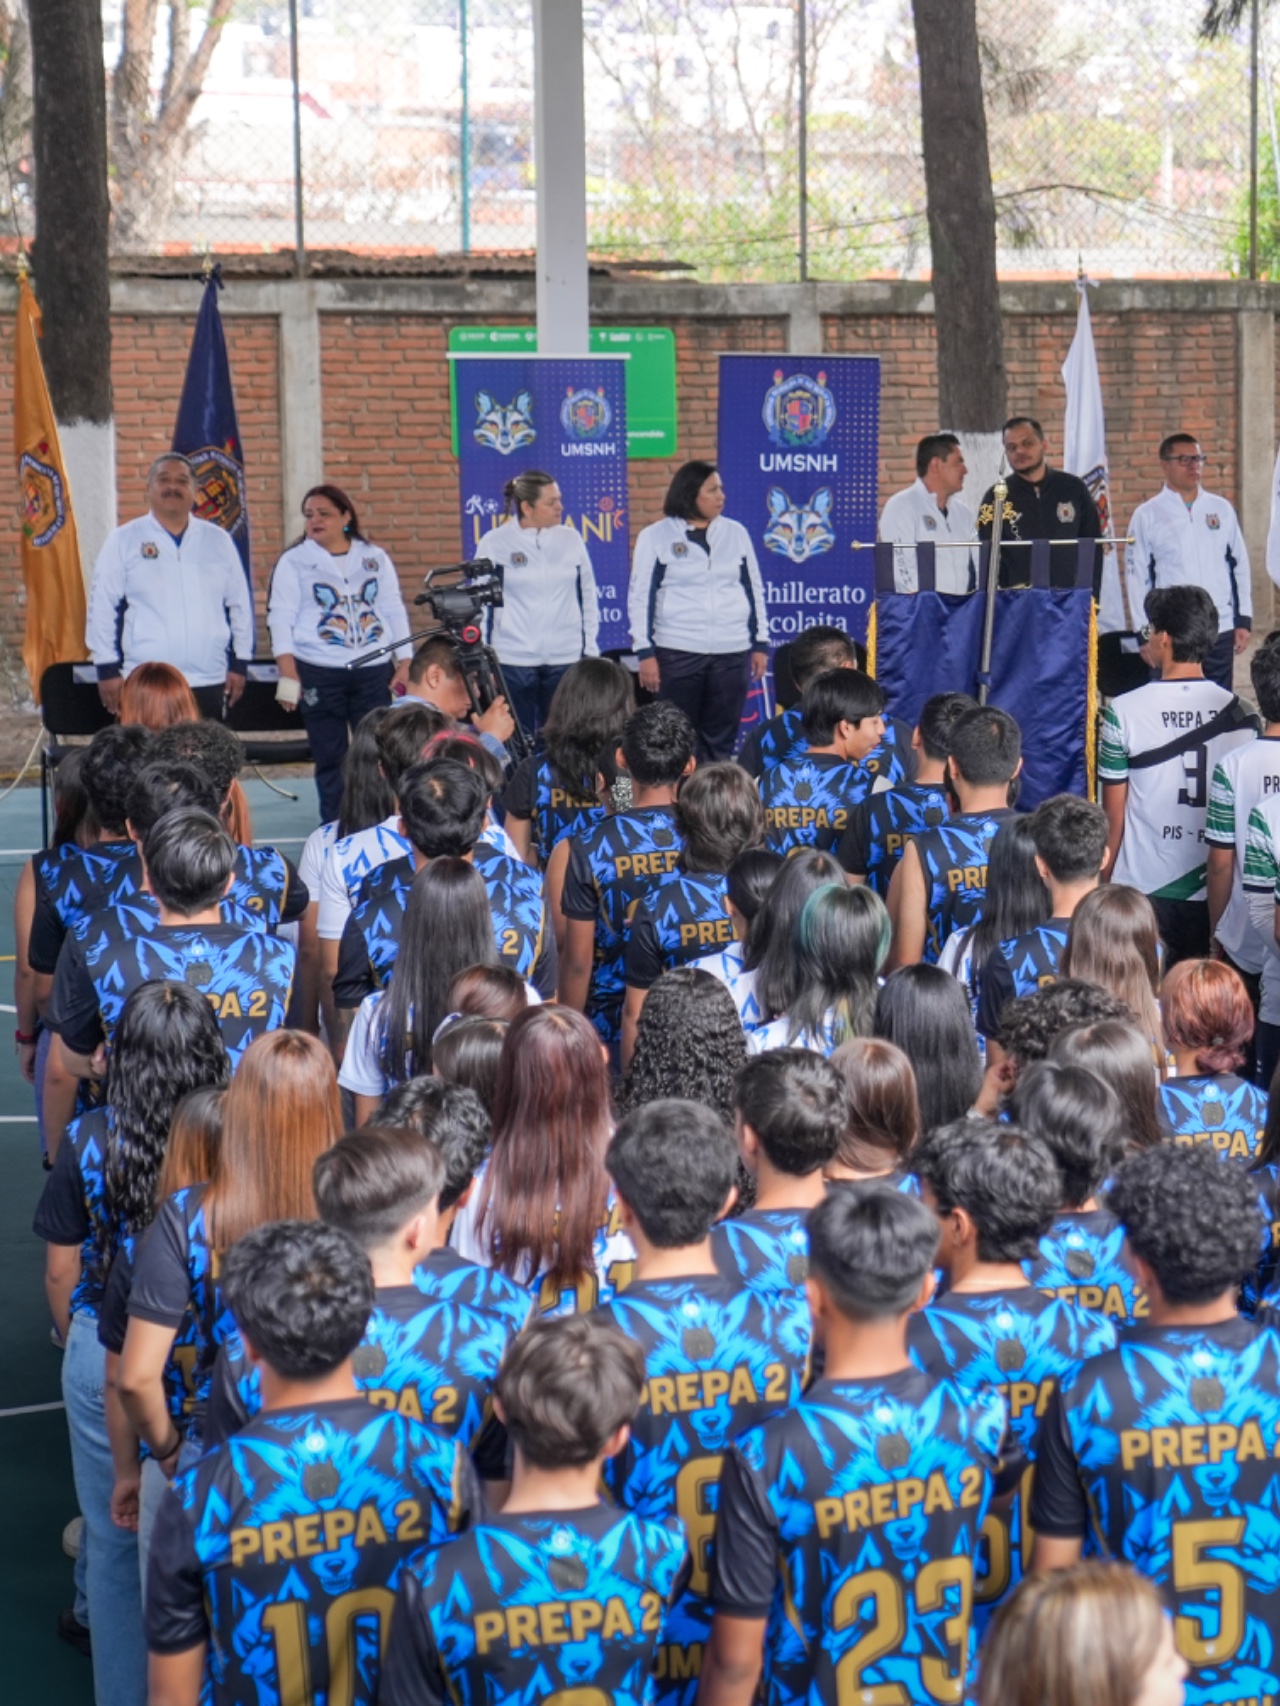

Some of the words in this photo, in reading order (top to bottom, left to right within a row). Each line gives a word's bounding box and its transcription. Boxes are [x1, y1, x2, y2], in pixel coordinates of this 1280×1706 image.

[561, 442, 616, 457] UMSNH
[759, 453, 838, 472] UMSNH
[1161, 711, 1202, 729] PREPA
[764, 808, 830, 831] PREPA
[833, 810, 848, 830] 2
[1162, 825, 1183, 842] PIS
[615, 851, 679, 878] PREP
[502, 929, 519, 955] 2
[680, 919, 739, 947] PRE
[249, 991, 268, 1017] 2
[764, 1363, 787, 1403] 2
[432, 1385, 458, 1424] 2
[1120, 1422, 1266, 1471] PREPA
[815, 1472, 954, 1540] PREPA
[960, 1465, 982, 1509] 2
[231, 1504, 387, 1569] PREPA
[394, 1499, 424, 1542] 2
[1171, 1516, 1245, 1668] 5
[474, 1596, 634, 1655] PREPA
[640, 1591, 661, 1632] 2
[833, 1554, 973, 1706] 23
